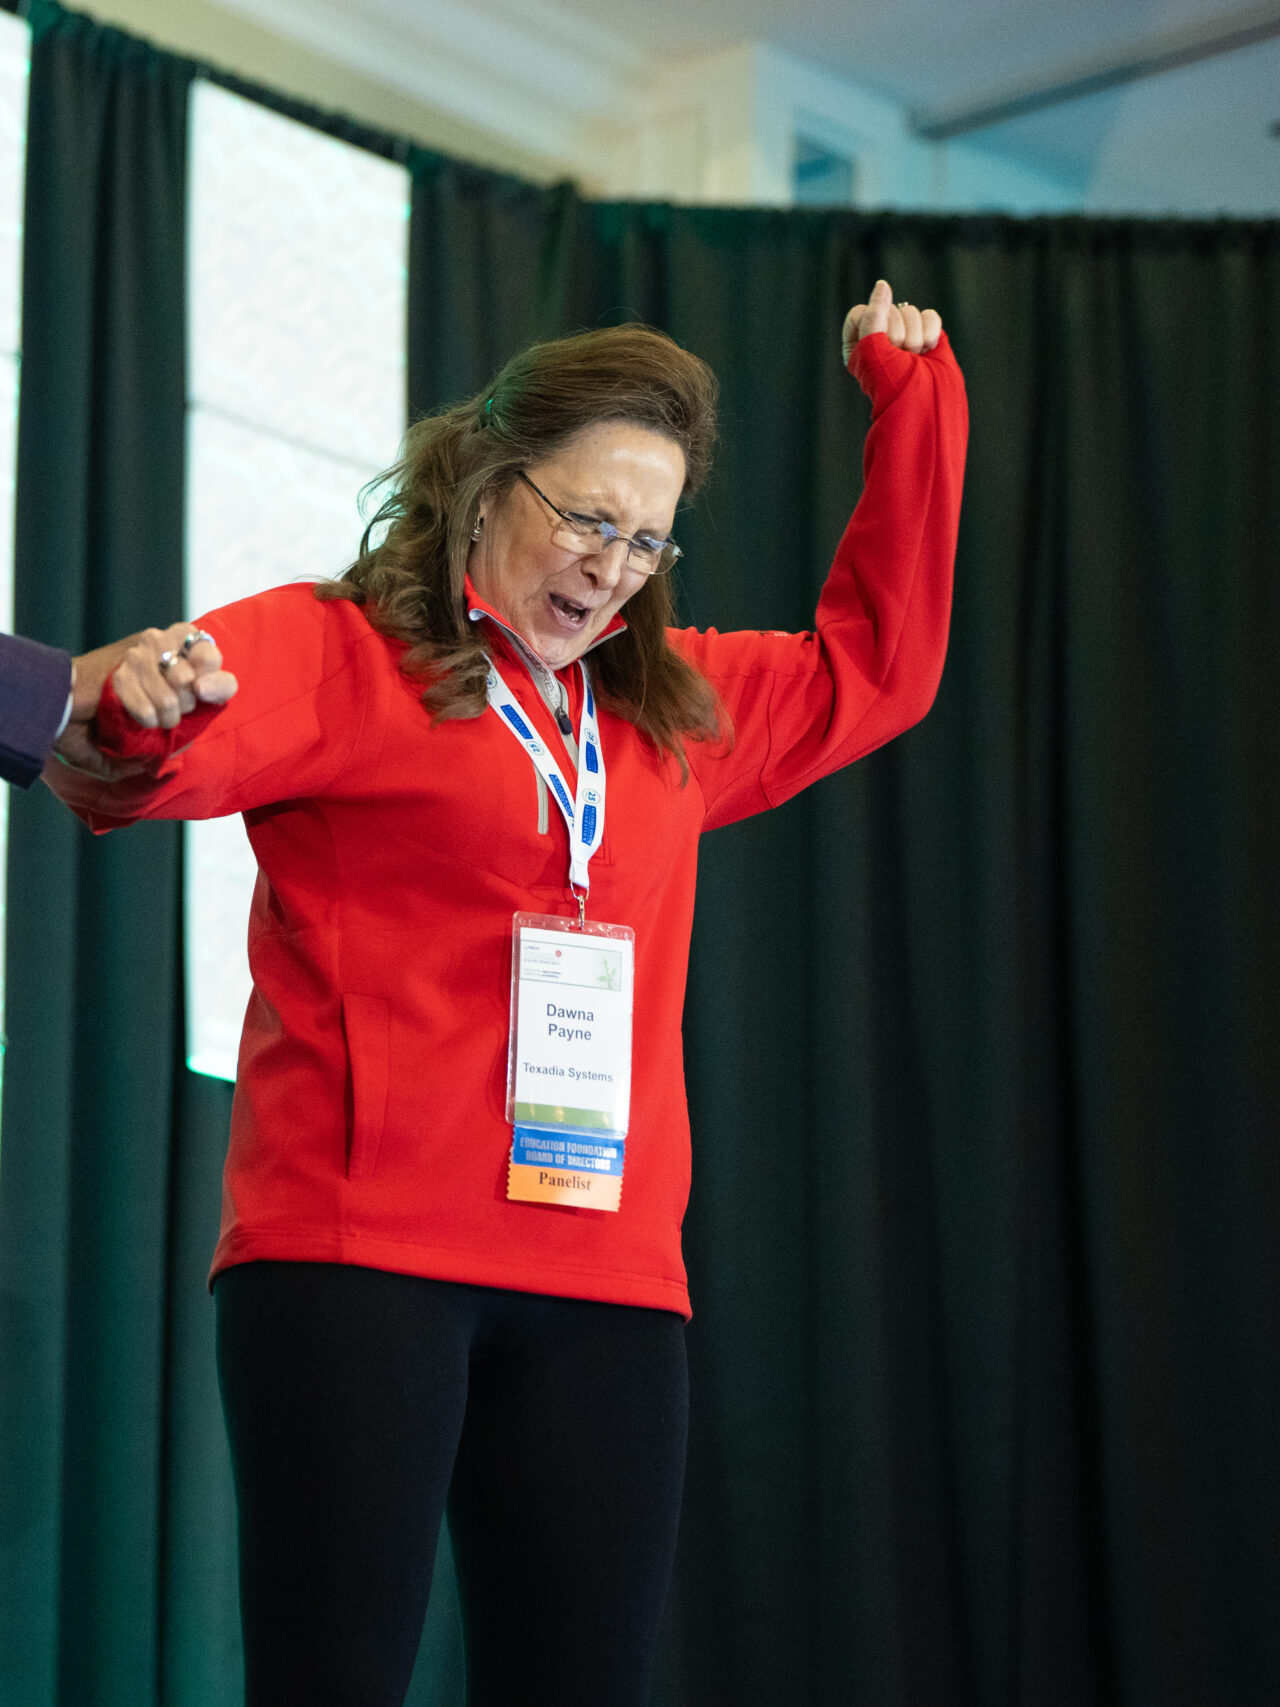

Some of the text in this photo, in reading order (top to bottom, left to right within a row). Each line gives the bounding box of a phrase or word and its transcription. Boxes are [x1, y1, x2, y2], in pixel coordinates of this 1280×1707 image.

[546, 1003, 594, 1022] Dawna
[548, 1023, 592, 1042] Payne
[523, 1062, 614, 1083] Texadia Systems
[520, 1137, 617, 1159] EDUCATION FOUNDATION
[525, 1150, 611, 1171] BOARD OF DIRECTORS
[539, 1171, 592, 1191] Panelist
